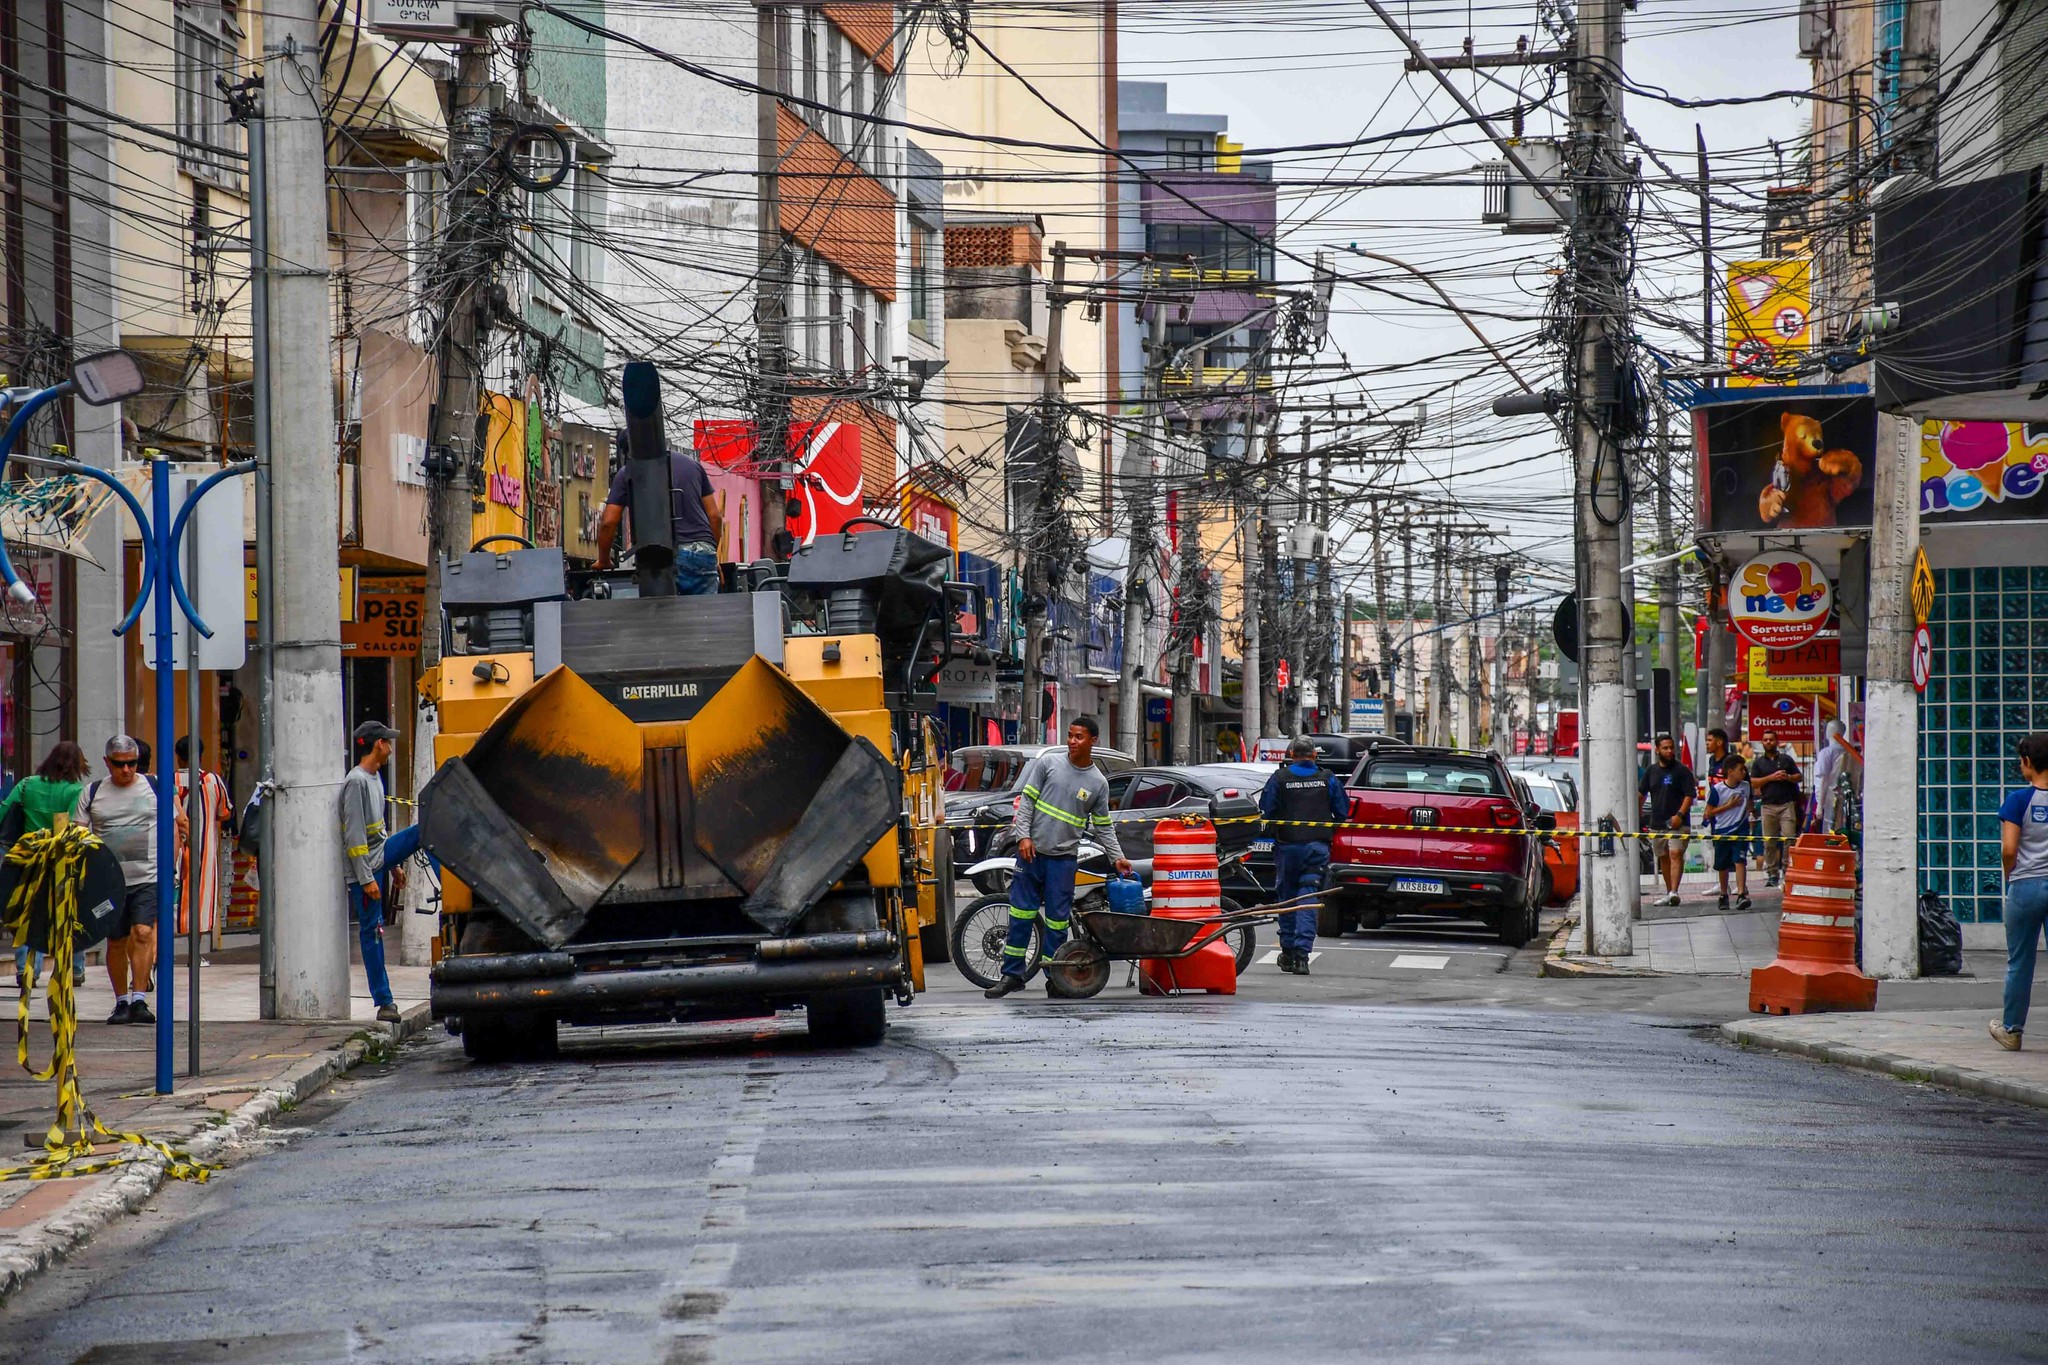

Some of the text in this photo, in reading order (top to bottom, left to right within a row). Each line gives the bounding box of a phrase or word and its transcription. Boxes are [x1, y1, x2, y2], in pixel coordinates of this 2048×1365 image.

[400, 10, 430, 21] enel
[363, 600, 418, 623] pas
[384, 620, 418, 637] su
[1751, 623, 1813, 634] Sorveteria
[1762, 635, 1804, 643] Self-service
[363, 642, 416, 653] CALÇAD
[942, 669, 992, 683] ROTA
[622, 683, 698, 700] CATERPILLAR
[1753, 715, 1787, 727] Óticas
[1286, 780, 1326, 790] GUARDA MUNICIPAL
[1416, 809, 1433, 823] FIAT
[1168, 871, 1213, 880] SUMTRAN
